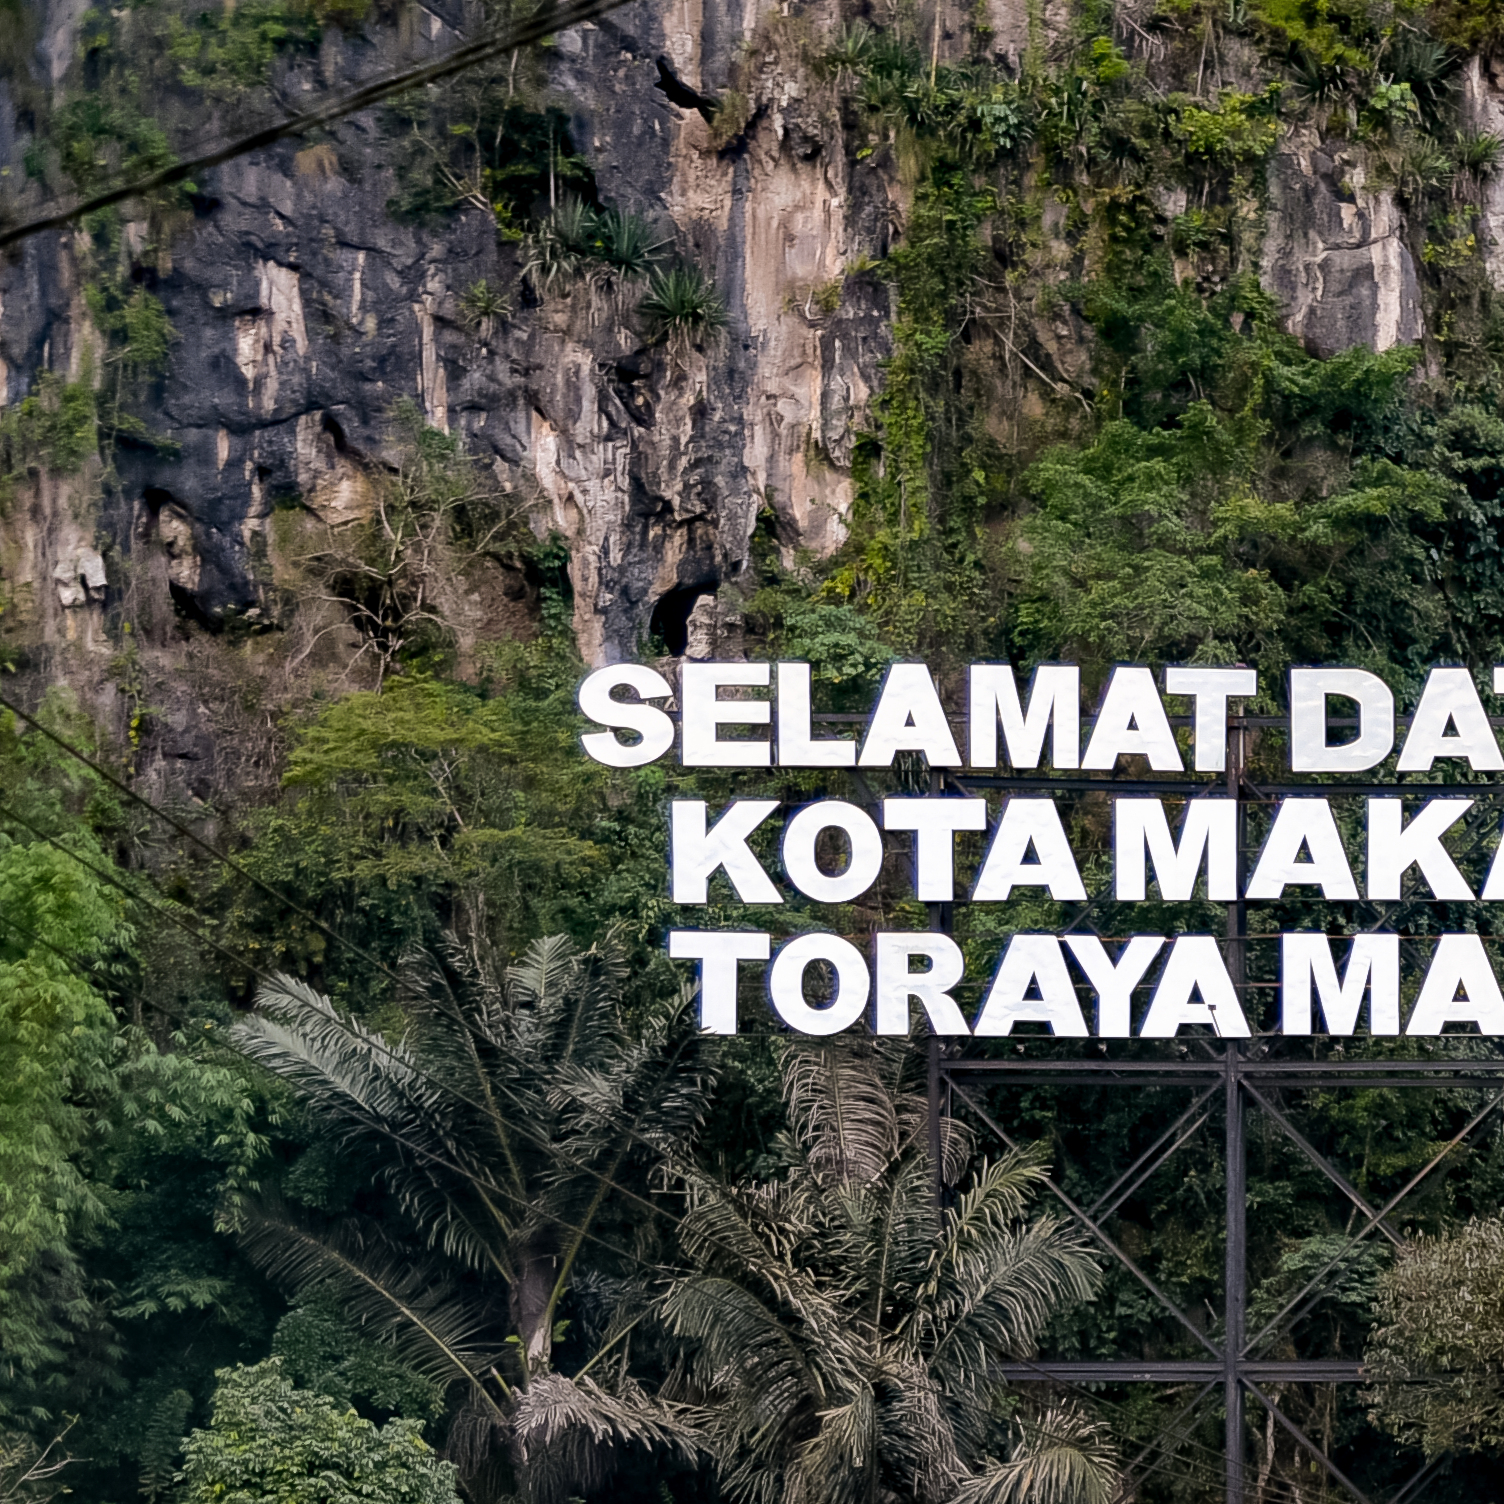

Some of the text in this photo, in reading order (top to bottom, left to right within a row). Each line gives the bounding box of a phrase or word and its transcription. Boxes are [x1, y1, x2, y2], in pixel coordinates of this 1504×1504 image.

[577, 662, 1257, 772] SELAMAT
[670, 799, 1088, 904] KOTA
[669, 931, 1252, 1038] TORAYA
